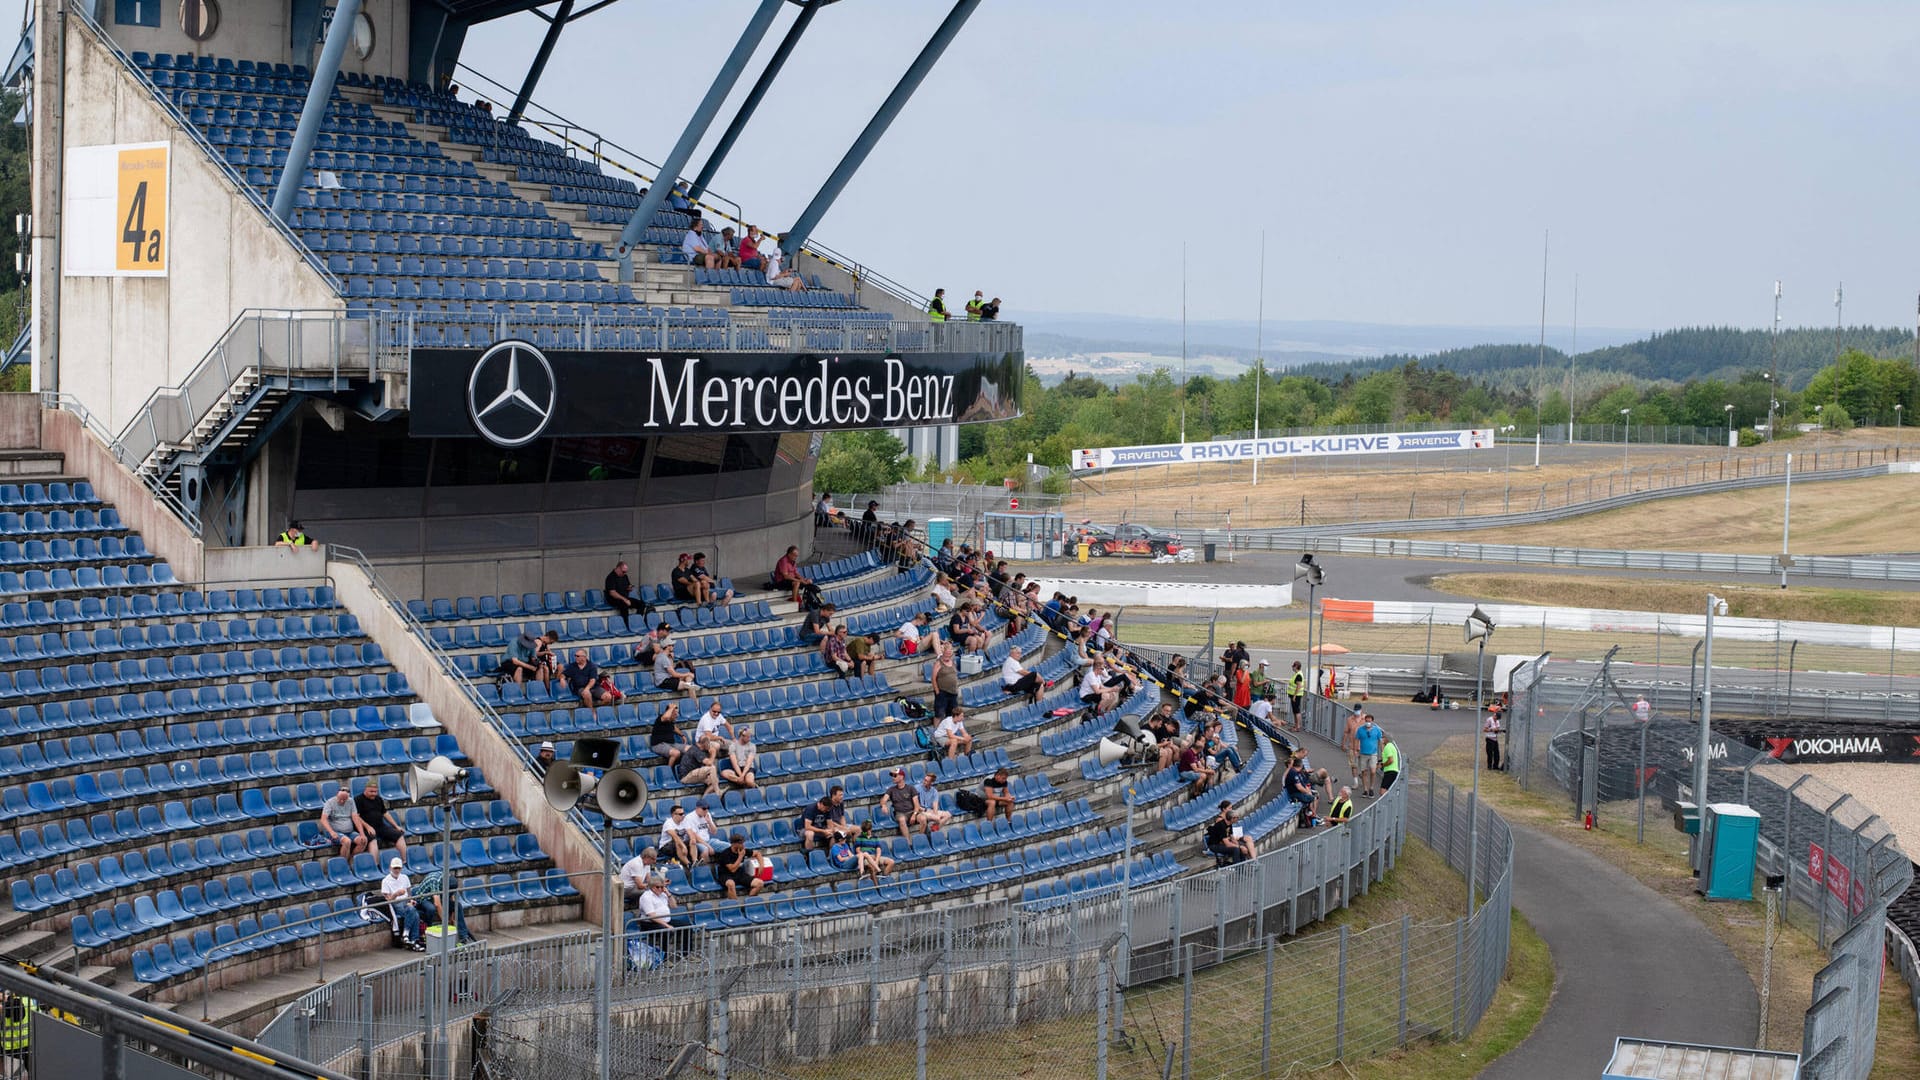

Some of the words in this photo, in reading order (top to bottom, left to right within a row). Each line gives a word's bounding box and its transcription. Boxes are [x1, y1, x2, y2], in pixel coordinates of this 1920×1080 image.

[122, 181, 161, 262] 4a
[643, 357, 954, 427] Mercedes-Benz
[1191, 436, 1390, 459] RAVENOL-KURVE
[1404, 436, 1456, 446] RAVENOL
[1118, 450, 1177, 461] RAVENOL
[1793, 737, 1883, 756] YOKOHAMA
